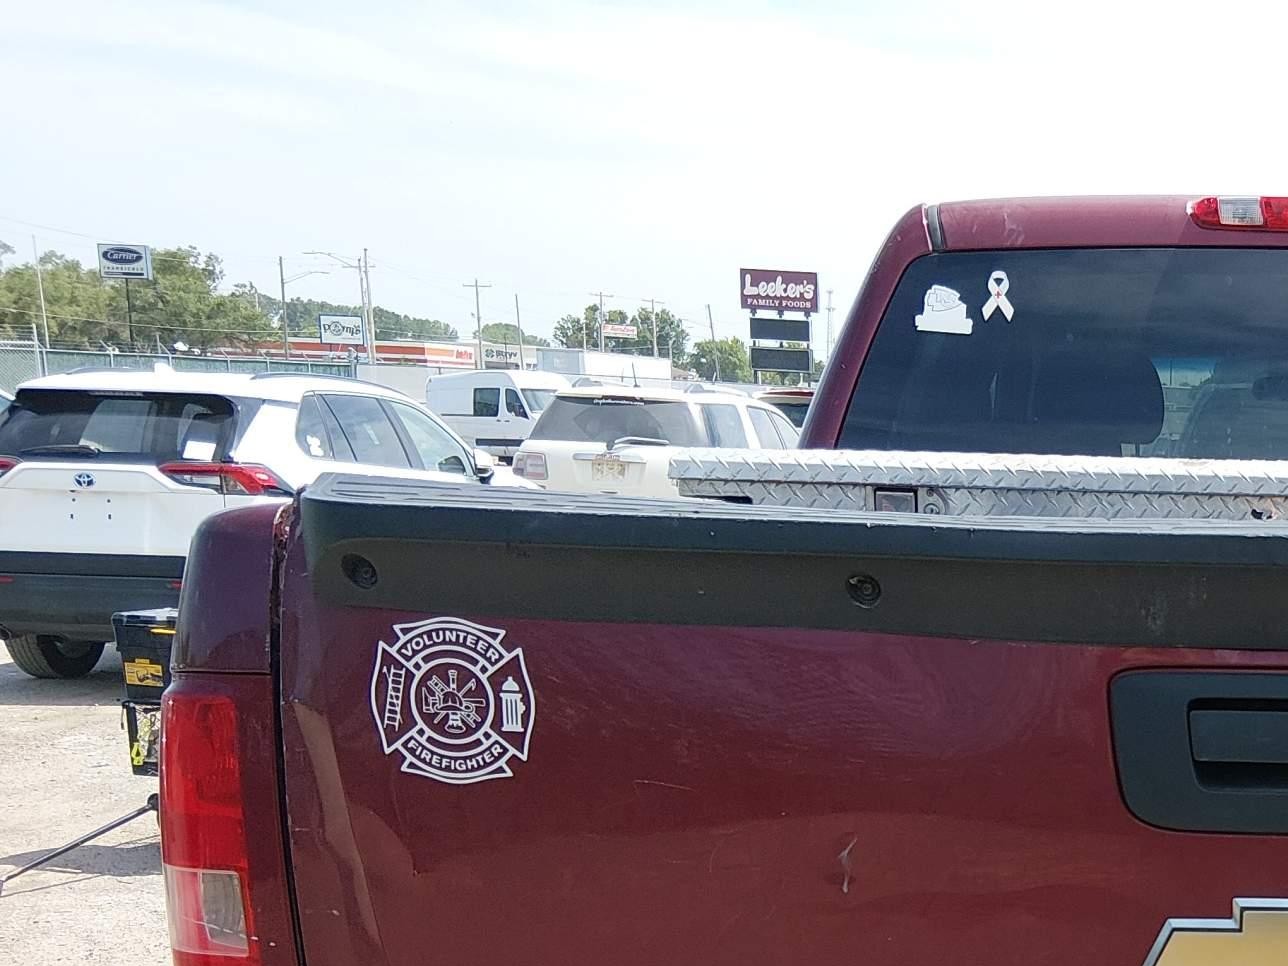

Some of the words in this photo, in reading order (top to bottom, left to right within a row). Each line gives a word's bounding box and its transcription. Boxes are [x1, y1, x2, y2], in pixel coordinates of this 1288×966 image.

[743, 273, 815, 299] Leeker's
[747, 298, 780, 306] FAMILY
[782, 300, 811, 308] FOODS
[401, 630, 500, 663] VOLUNTEER
[406, 738, 503, 771] FIREFIGHTER
